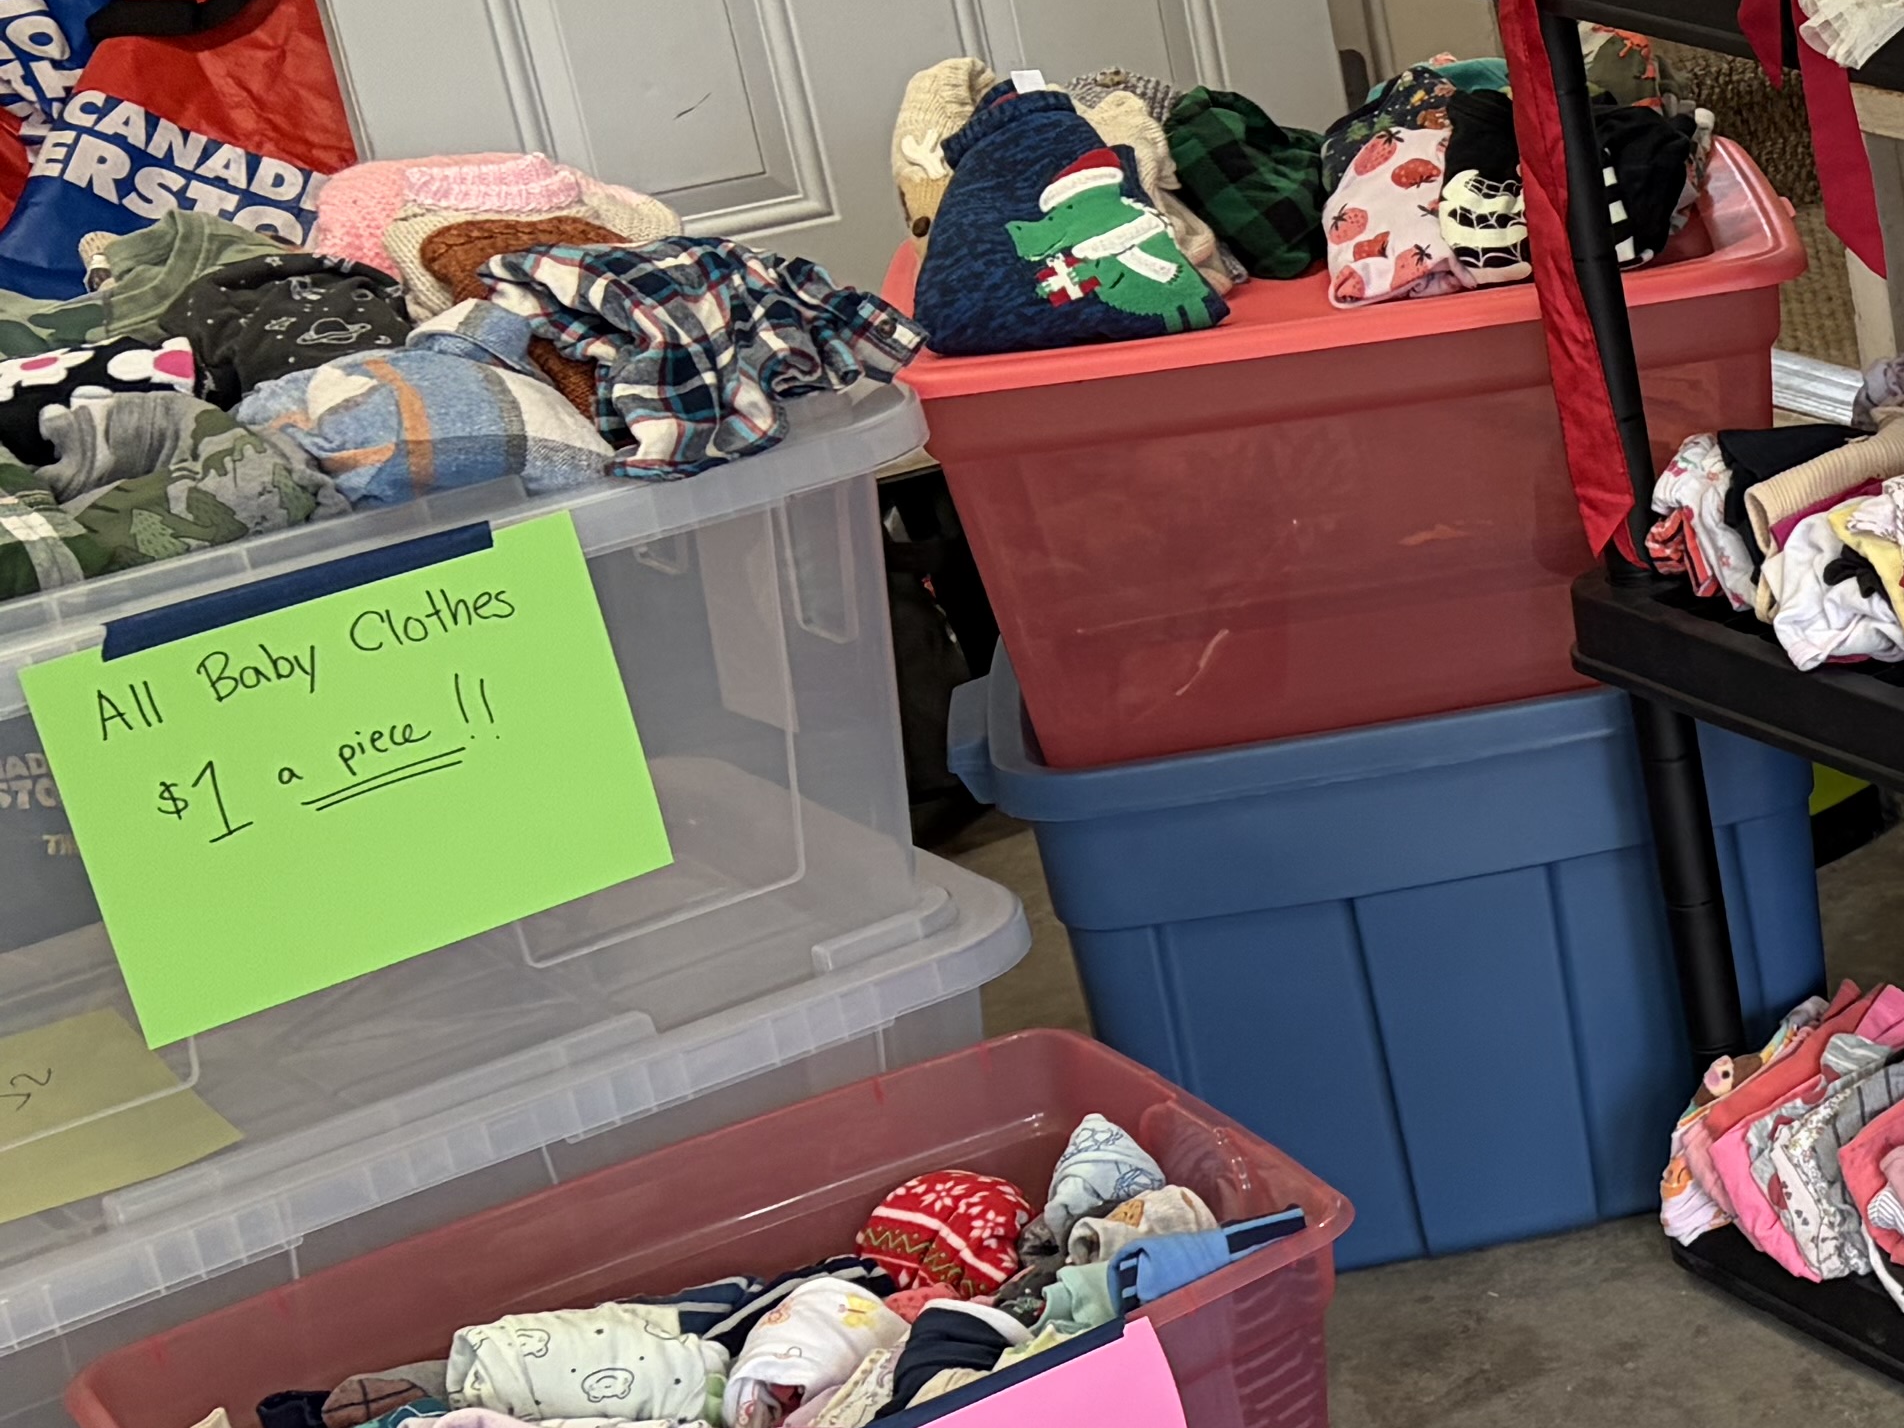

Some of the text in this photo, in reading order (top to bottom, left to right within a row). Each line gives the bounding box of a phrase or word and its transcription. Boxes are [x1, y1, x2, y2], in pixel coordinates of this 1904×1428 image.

[96, 585, 516, 742] All Baby Clothes
[157, 759, 254, 844] $1
[277, 766, 304, 785] a
